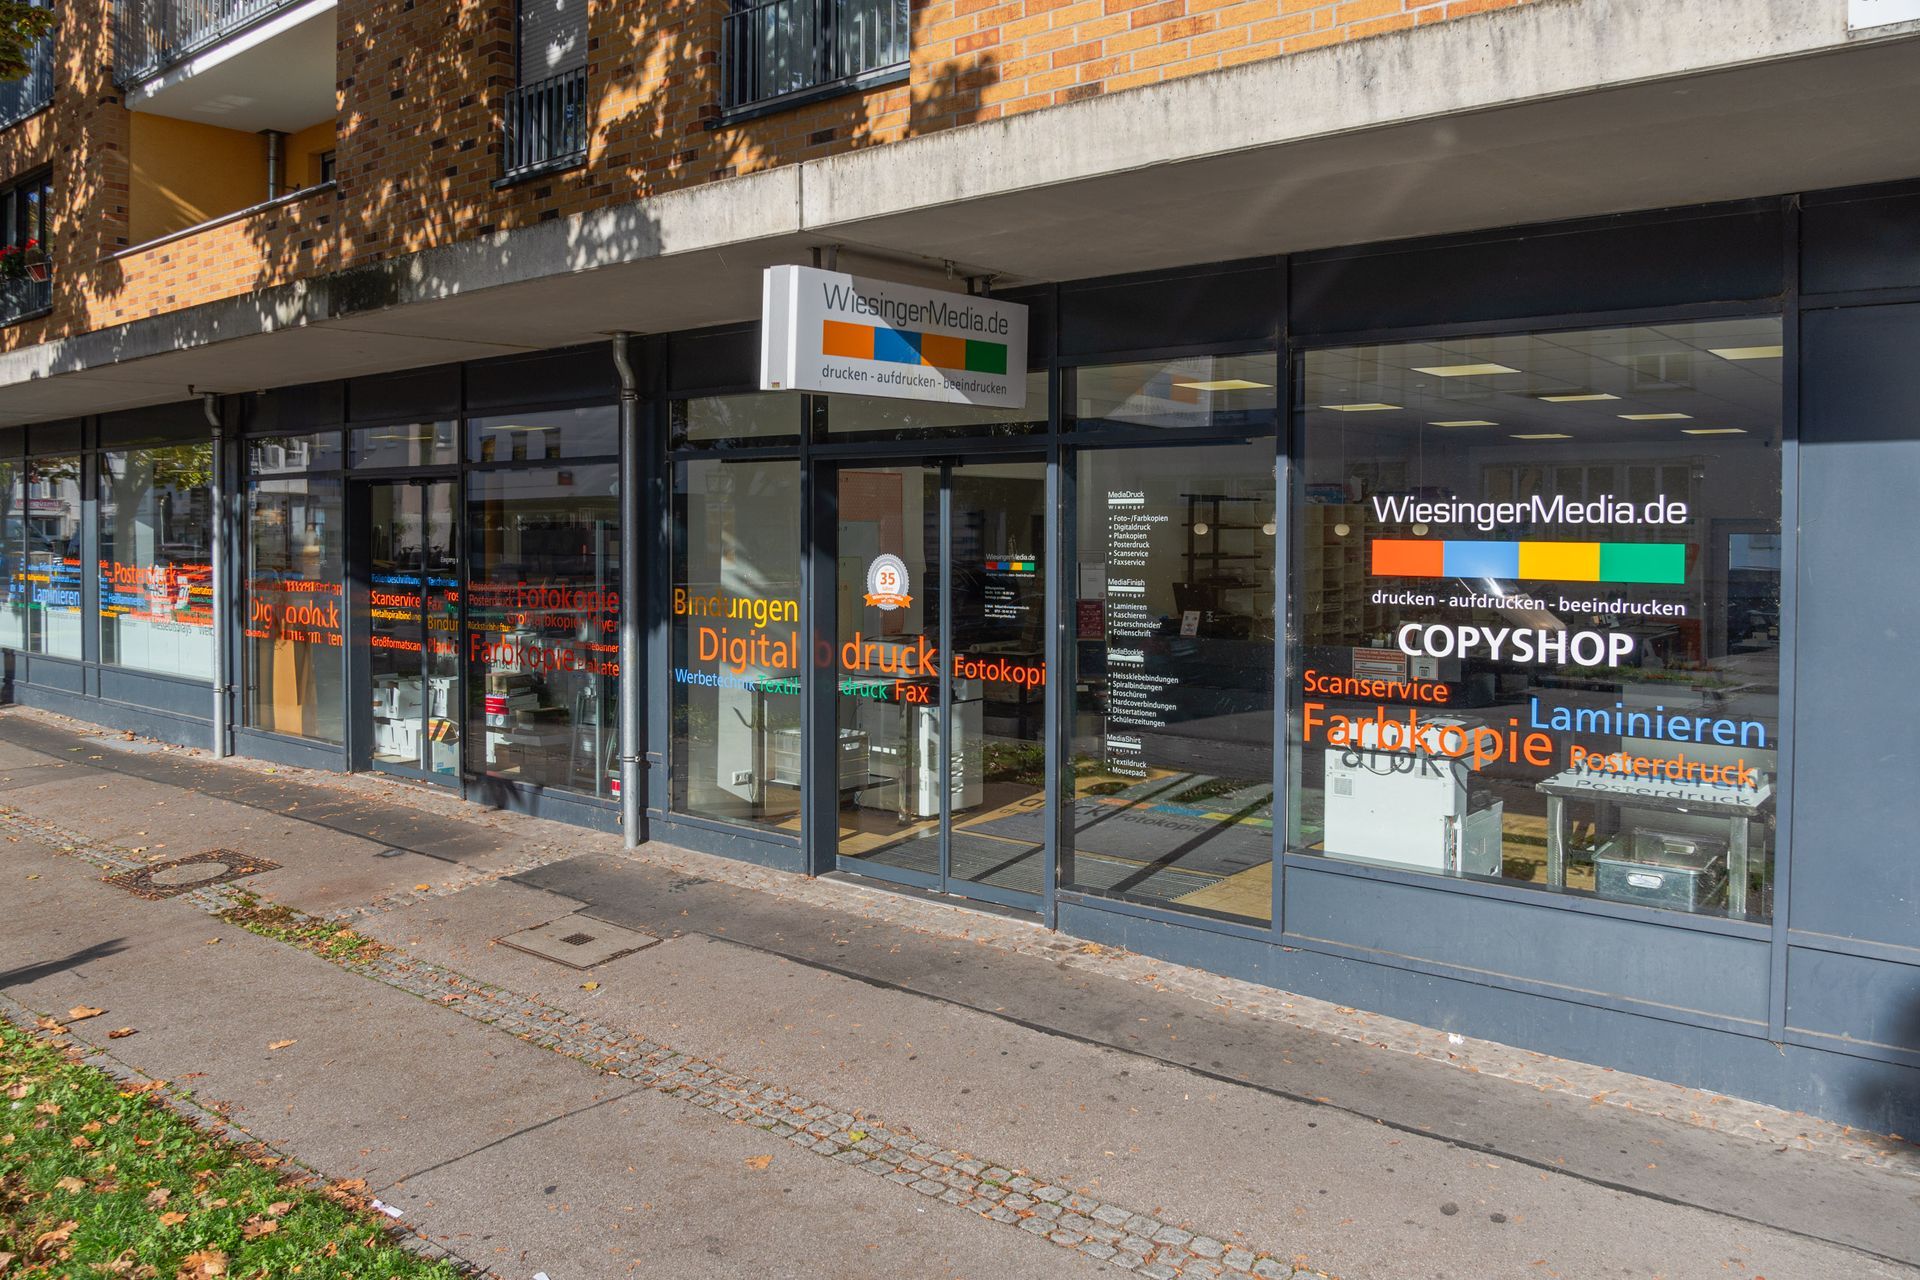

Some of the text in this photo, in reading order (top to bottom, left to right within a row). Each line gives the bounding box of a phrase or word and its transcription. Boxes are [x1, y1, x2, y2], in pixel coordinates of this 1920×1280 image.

[824, 282, 1009, 335] WiesingerMedia.de
[822, 364, 1007, 395] drucken aufdrucken beeindrucken
[1372, 494, 1688, 532] WiesingerMedia.de
[1113, 523, 1152, 532] Digitaldruck
[1113, 532, 1148, 541] Plankopien
[1113, 541, 1150, 549] Posterdruck
[1113, 550, 1149, 558] Scanservice
[1113, 558, 1146, 567] Faxservice
[880, 572, 896, 586] 35
[32, 583, 80, 606] Laminieren
[371, 590, 421, 609] Scanservice
[517, 581, 620, 619] Fotokopie
[673, 588, 799, 629] Bindungen
[1113, 603, 1148, 611] Laminieren
[1371, 590, 1687, 617] drucken aufdrucken beeindrucken
[1113, 611, 1147, 620] Kaschieren
[1113, 629, 1152, 638] Folienschrift
[699, 627, 798, 676] Digital
[841, 631, 939, 677] druck
[1397, 623, 1635, 668] COPYSHOP
[470, 633, 575, 678] Farbkopie
[675, 668, 929, 704] Werbetechnik Textil druck Fax
[1112, 680, 1163, 694] Spiralbindungen
[1303, 669, 1449, 703] Scanservice
[1112, 689, 1147, 700] Broschüren
[1112, 698, 1177, 711] Hardcoverbindungen
[1112, 706, 1157, 718] Dissertationen
[1112, 715, 1166, 728] Schülerzeitungen
[1531, 697, 1766, 748] Laminieren
[1303, 702, 1554, 772] Farbkopie
[1112, 757, 1148, 769] Textildruck
[1569, 745, 1756, 788] Posterdruck
[1112, 766, 1147, 778] Mousepads
